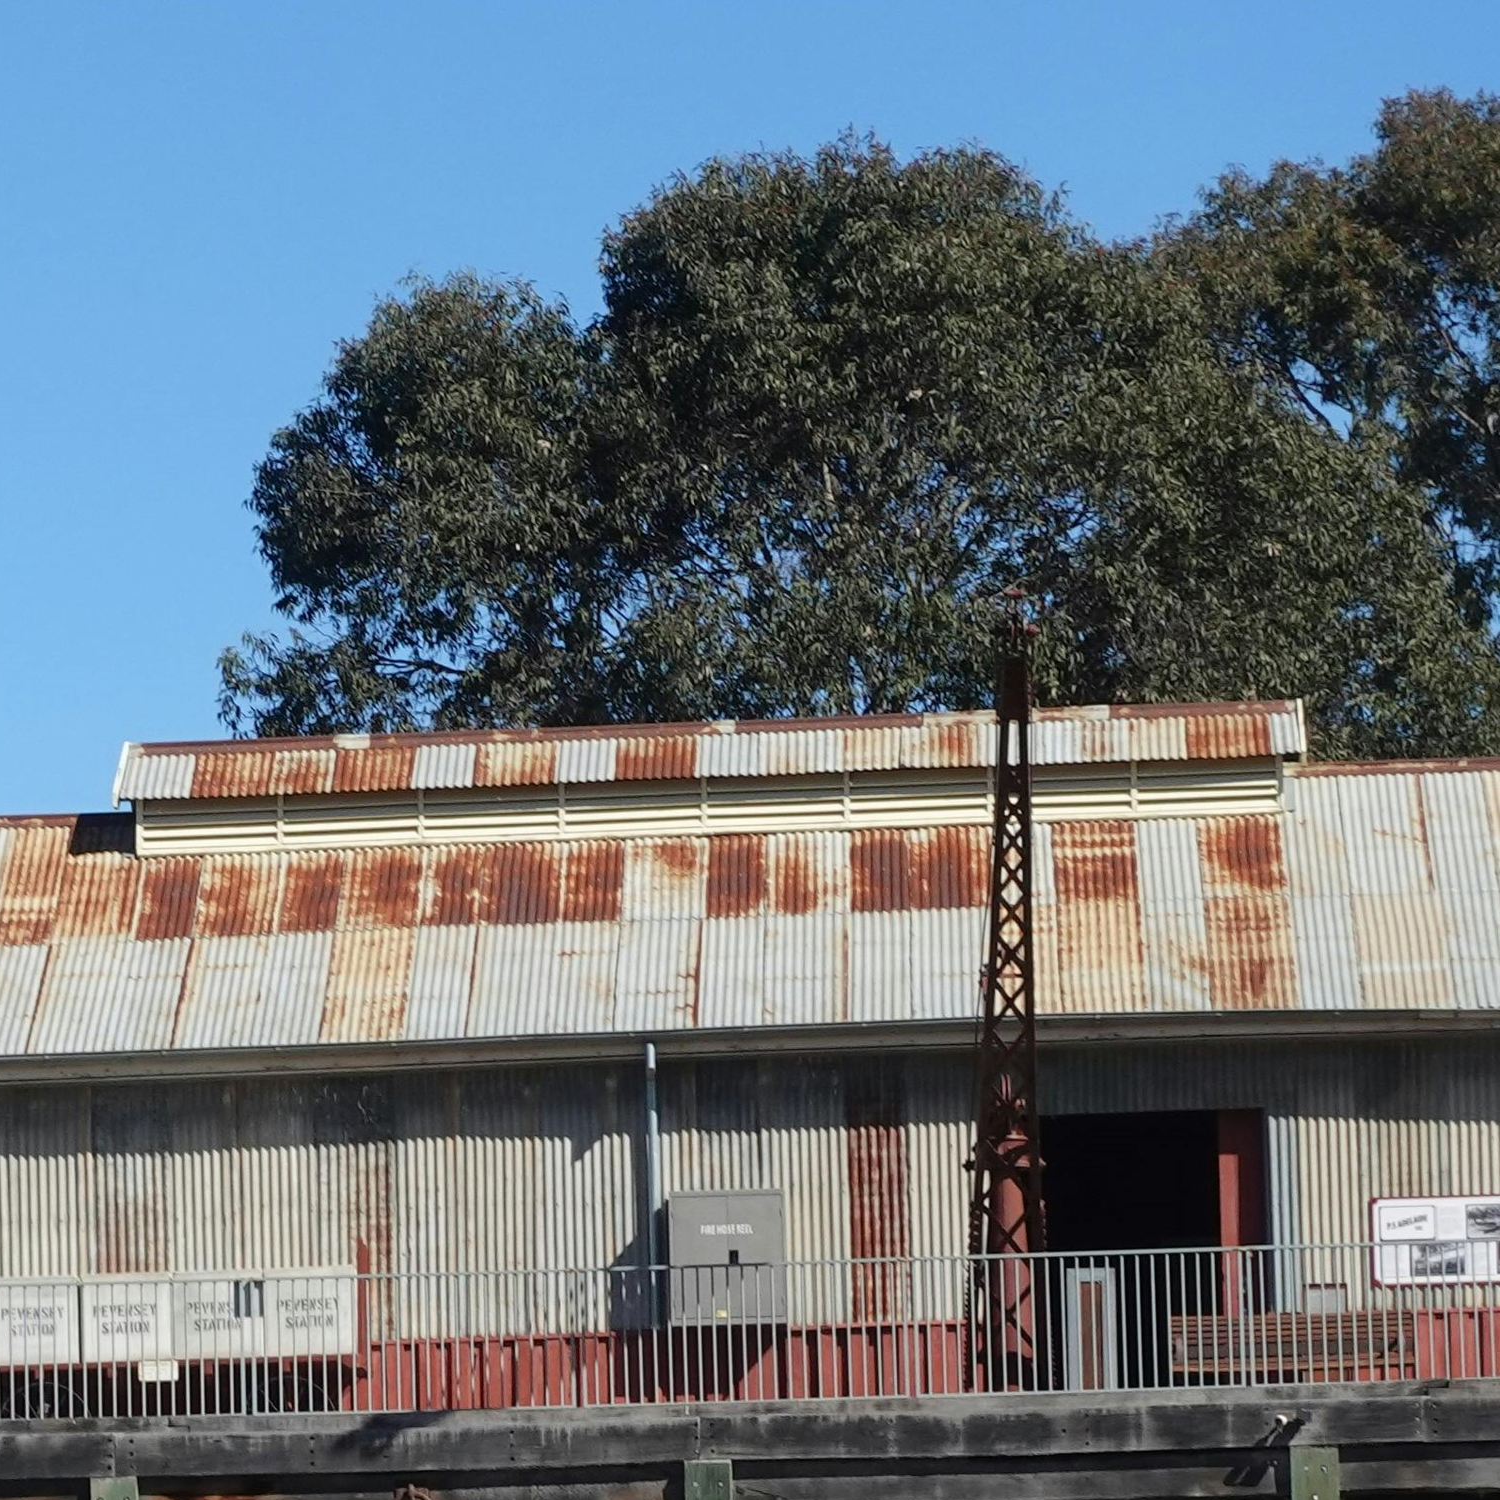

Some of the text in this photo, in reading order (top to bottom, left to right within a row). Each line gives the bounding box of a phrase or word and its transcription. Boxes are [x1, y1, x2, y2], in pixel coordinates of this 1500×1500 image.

[700, 1223, 754, 1235] FIRE HOSE REEL
[187, 1302, 234, 1315] PEVENS
[102, 1320, 150, 1335] STATION
[285, 1314, 334, 1329] STATION
[11, 1323, 56, 1337] STATION
